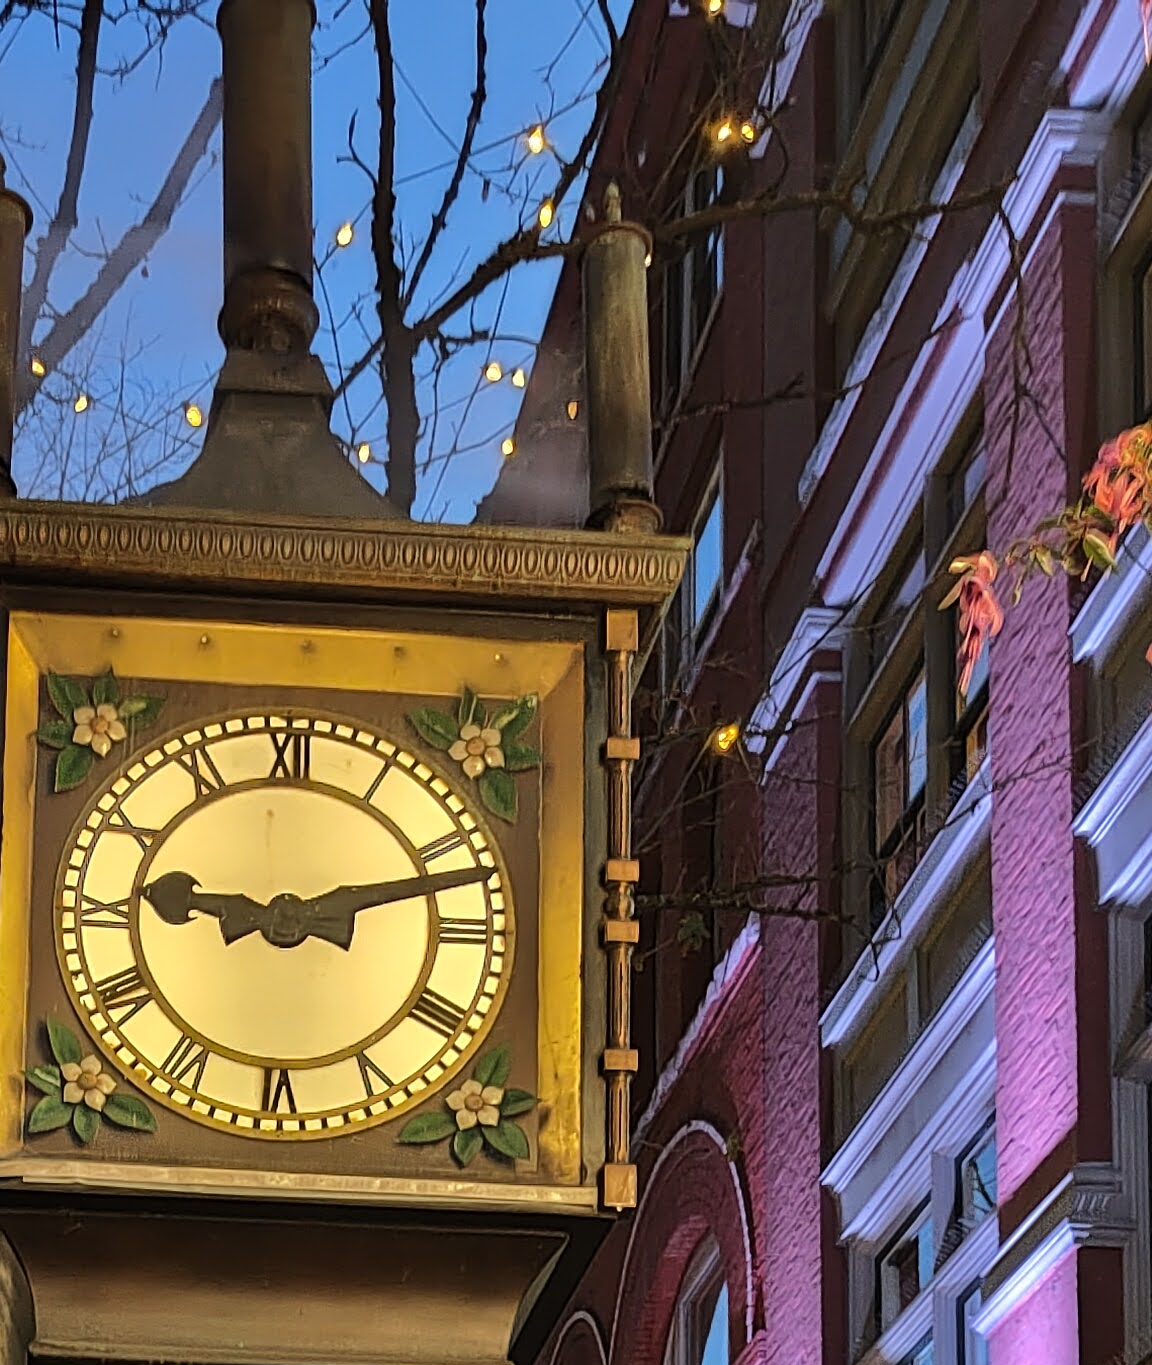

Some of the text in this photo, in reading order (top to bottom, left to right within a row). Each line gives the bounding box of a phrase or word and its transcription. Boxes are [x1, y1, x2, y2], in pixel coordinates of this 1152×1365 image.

[176, 747, 226, 798] XI
[269, 733, 311, 778] XII
[415, 829, 465, 863] II
[81, 895, 131, 928] IX
[438, 916, 486, 945] III
[262, 1068, 298, 1114] VI
